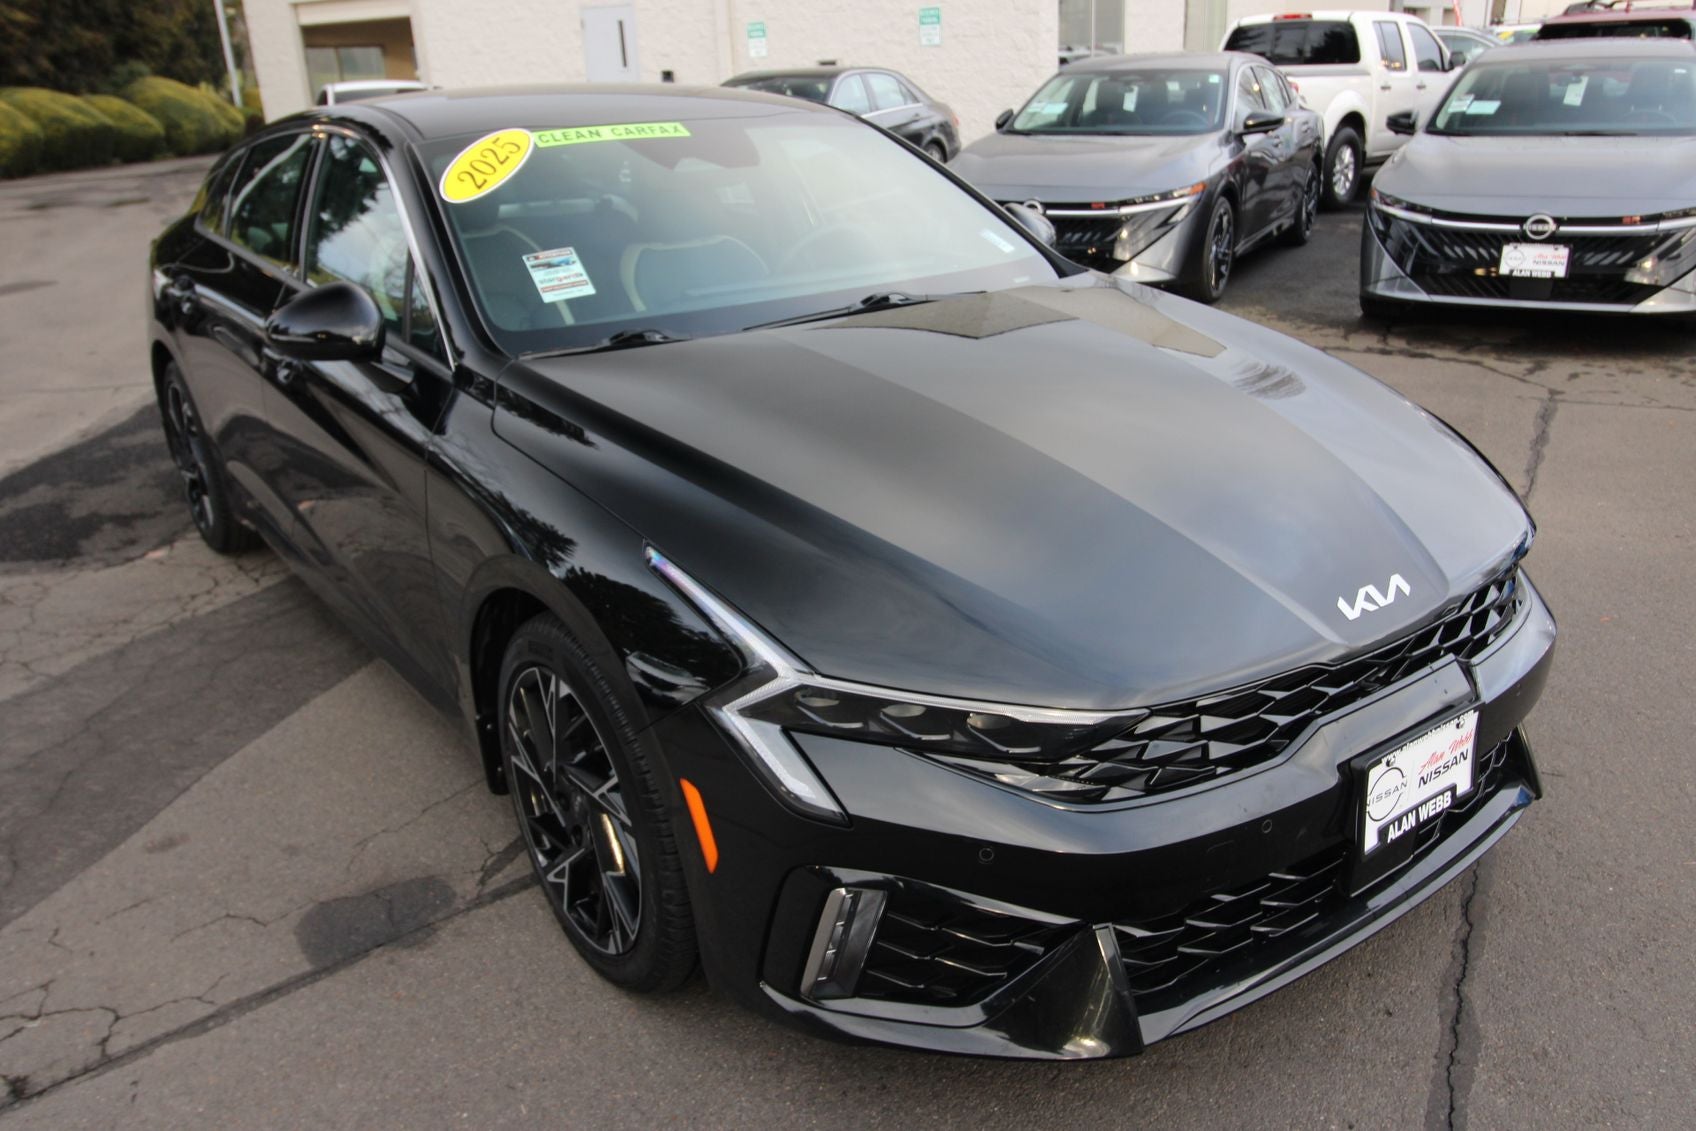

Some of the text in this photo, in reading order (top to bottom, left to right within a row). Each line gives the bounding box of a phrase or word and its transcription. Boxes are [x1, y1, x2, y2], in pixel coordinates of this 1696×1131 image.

[538, 124, 684, 144] CLEAN CARFAX
[457, 137, 521, 190] 2025
[1337, 573, 1411, 621] KIA
[1418, 729, 1473, 775] Alan Webb
[1418, 748, 1469, 788] NISSAN
[1387, 790, 1452, 844] ALAN WEBB
